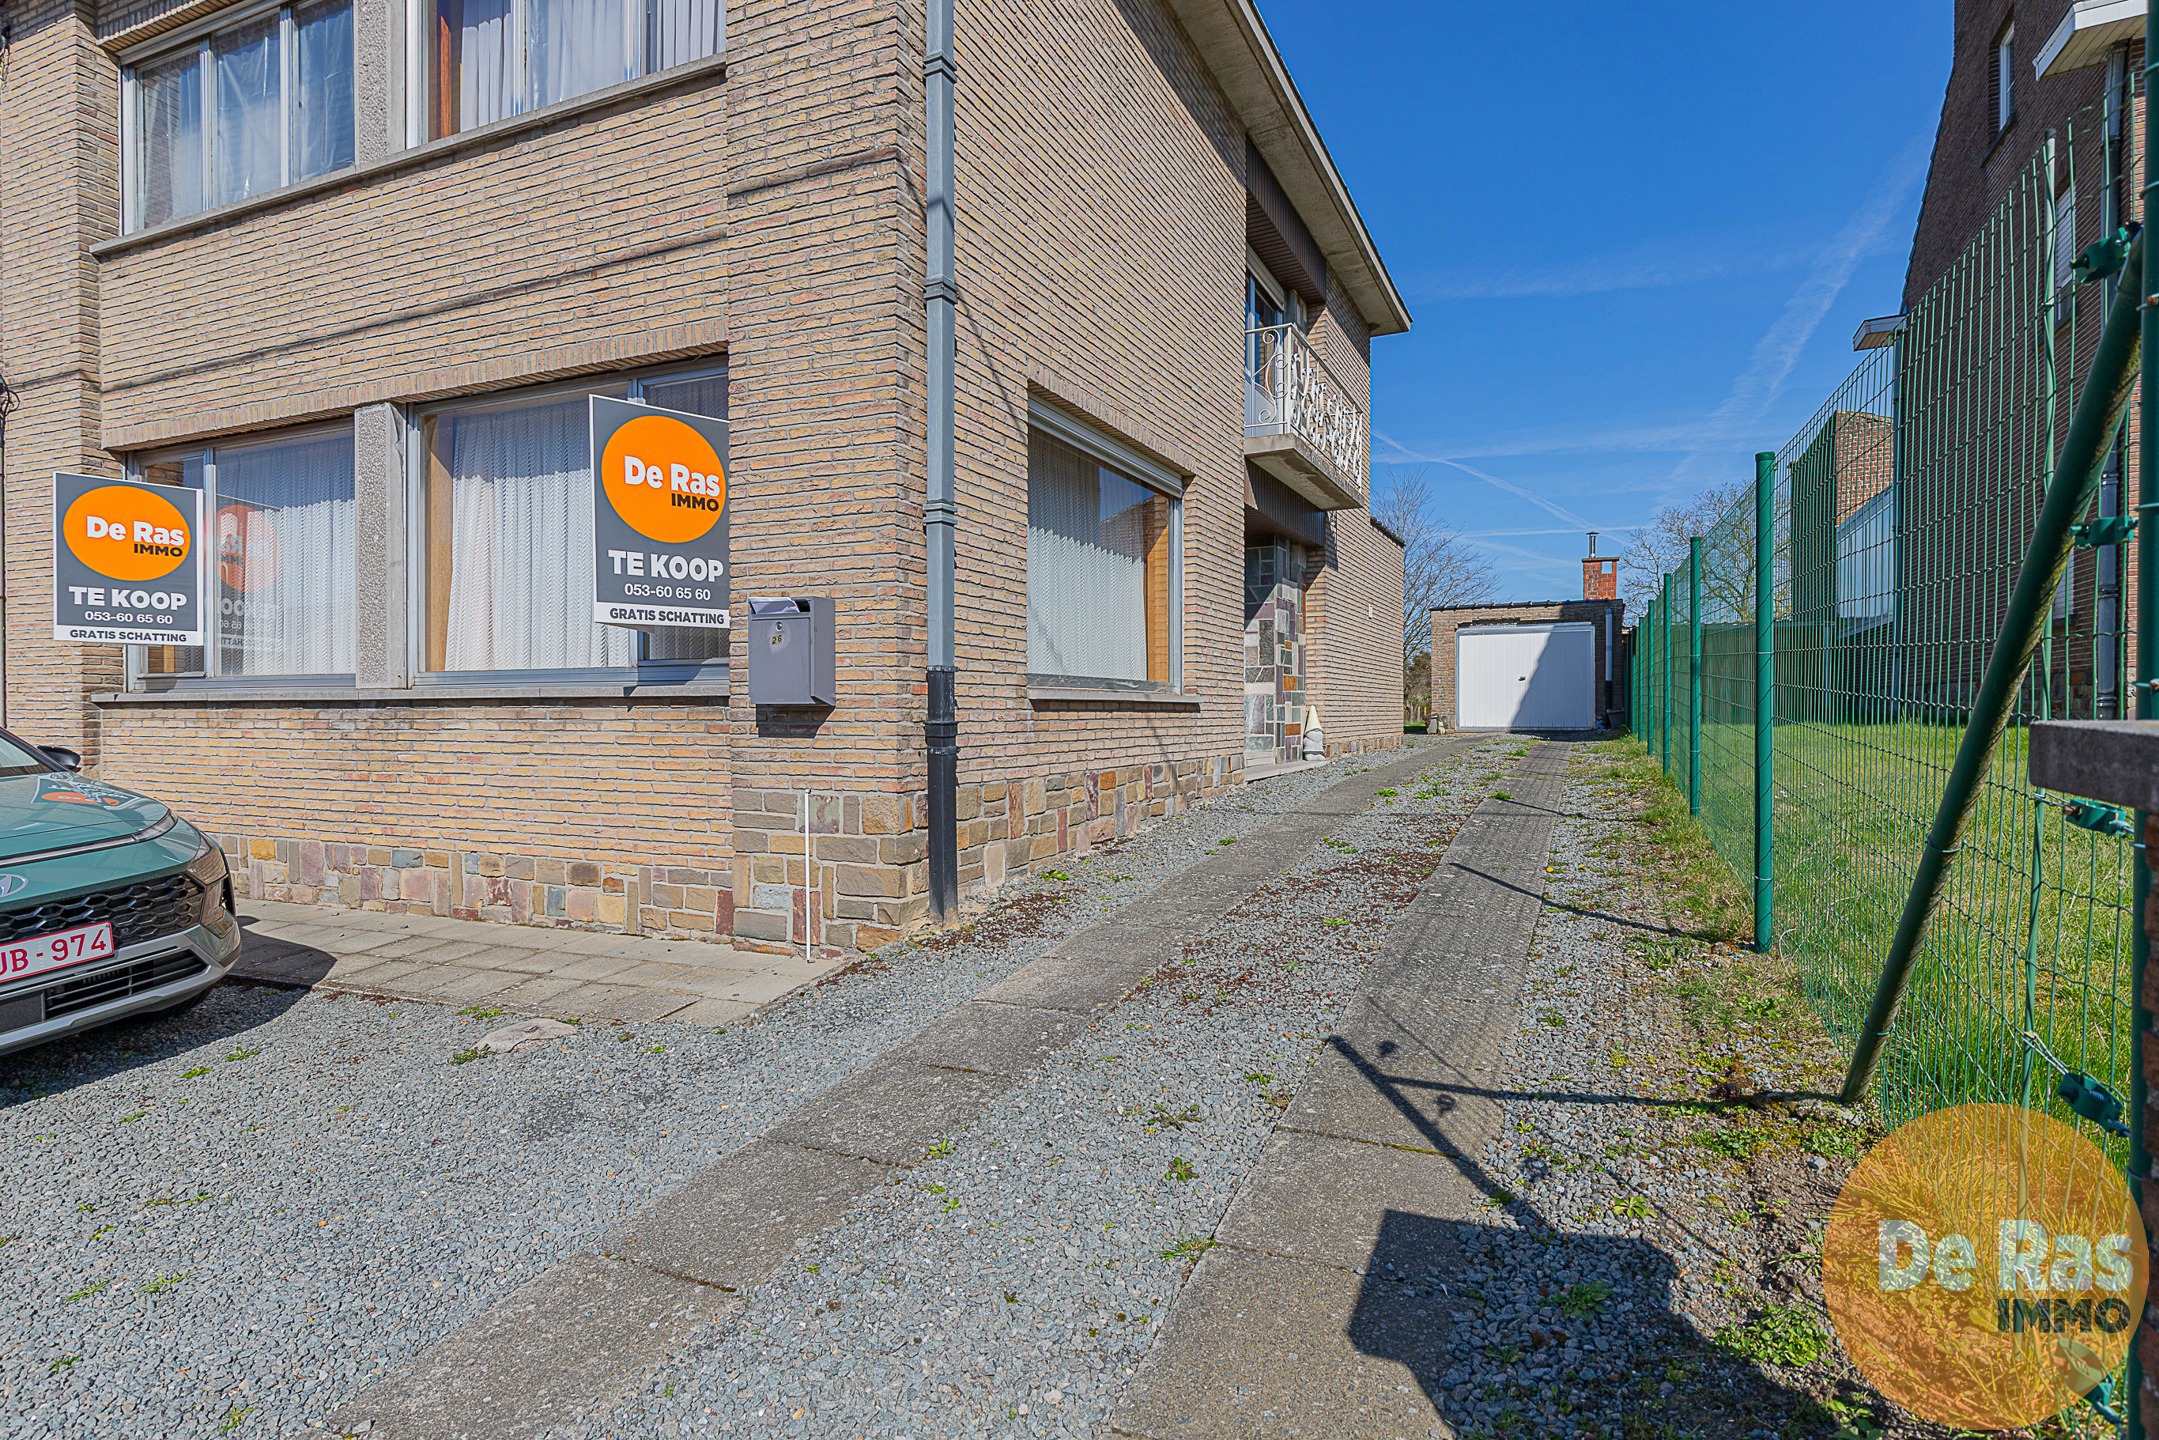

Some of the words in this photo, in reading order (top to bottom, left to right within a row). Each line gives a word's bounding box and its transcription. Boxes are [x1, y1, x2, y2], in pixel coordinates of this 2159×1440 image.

[624, 455, 663, 489] De
[670, 463, 721, 497] Ras
[671, 493, 720, 513] IMMO
[86, 516, 126, 541] De
[133, 521, 185, 546] Ras
[133, 543, 184, 557] IMMO
[607, 549, 645, 577] TE
[650, 553, 724, 583] KOOP
[68, 586, 106, 606] TE
[111, 588, 188, 611] KOOP
[624, 583, 673, 598] 053-60
[675, 587, 692, 599] 65
[695, 589, 711, 601] 60
[84, 610, 134, 623] 053-60
[136, 613, 154, 623] 65
[156, 614, 173, 625] 60
[609, 607, 656, 622] GRATIS
[658, 610, 725, 625] SCHATTING
[69, 629, 116, 640] GRATIS
[118, 631, 187, 642] SCHATTING
[771, 635, 783, 645] 26
